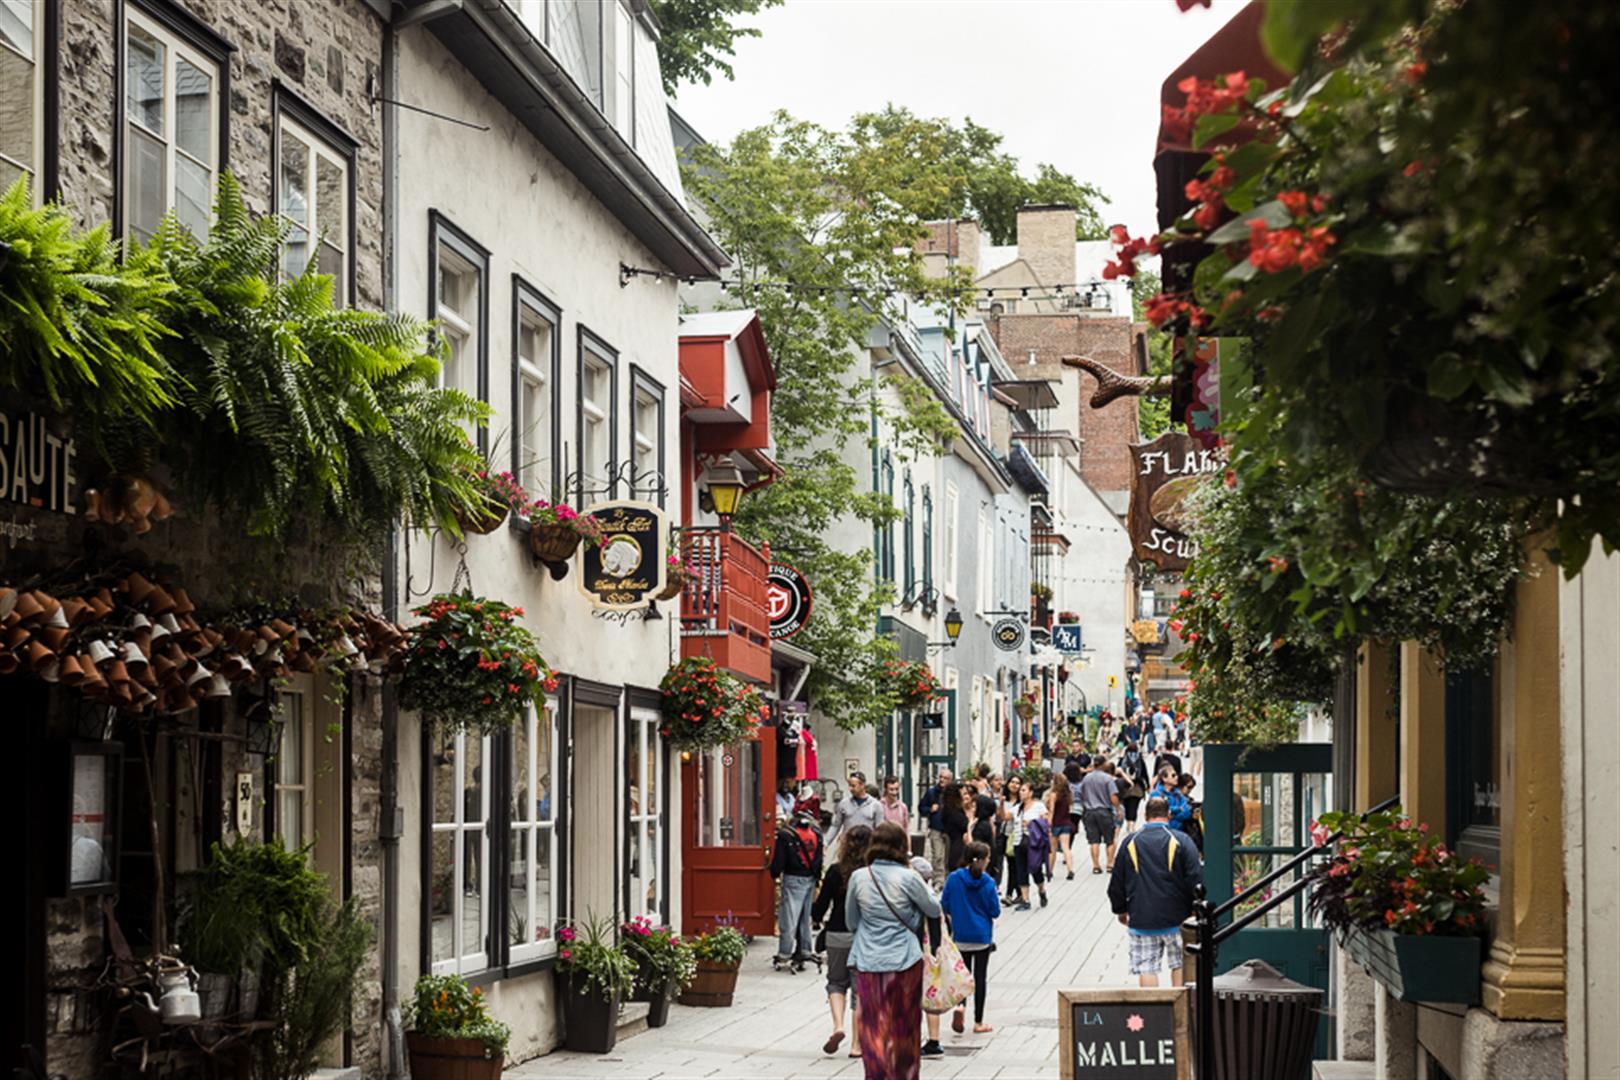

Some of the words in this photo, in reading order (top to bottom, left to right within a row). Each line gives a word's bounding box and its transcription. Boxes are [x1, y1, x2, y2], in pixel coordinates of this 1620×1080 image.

[0, 411, 77, 514] SAUTÉ
[1139, 450, 1227, 475] FLAM
[768, 565, 799, 581] TIQUE
[1083, 1012, 1104, 1025] LA
[1078, 1040, 1175, 1067] MALLE
